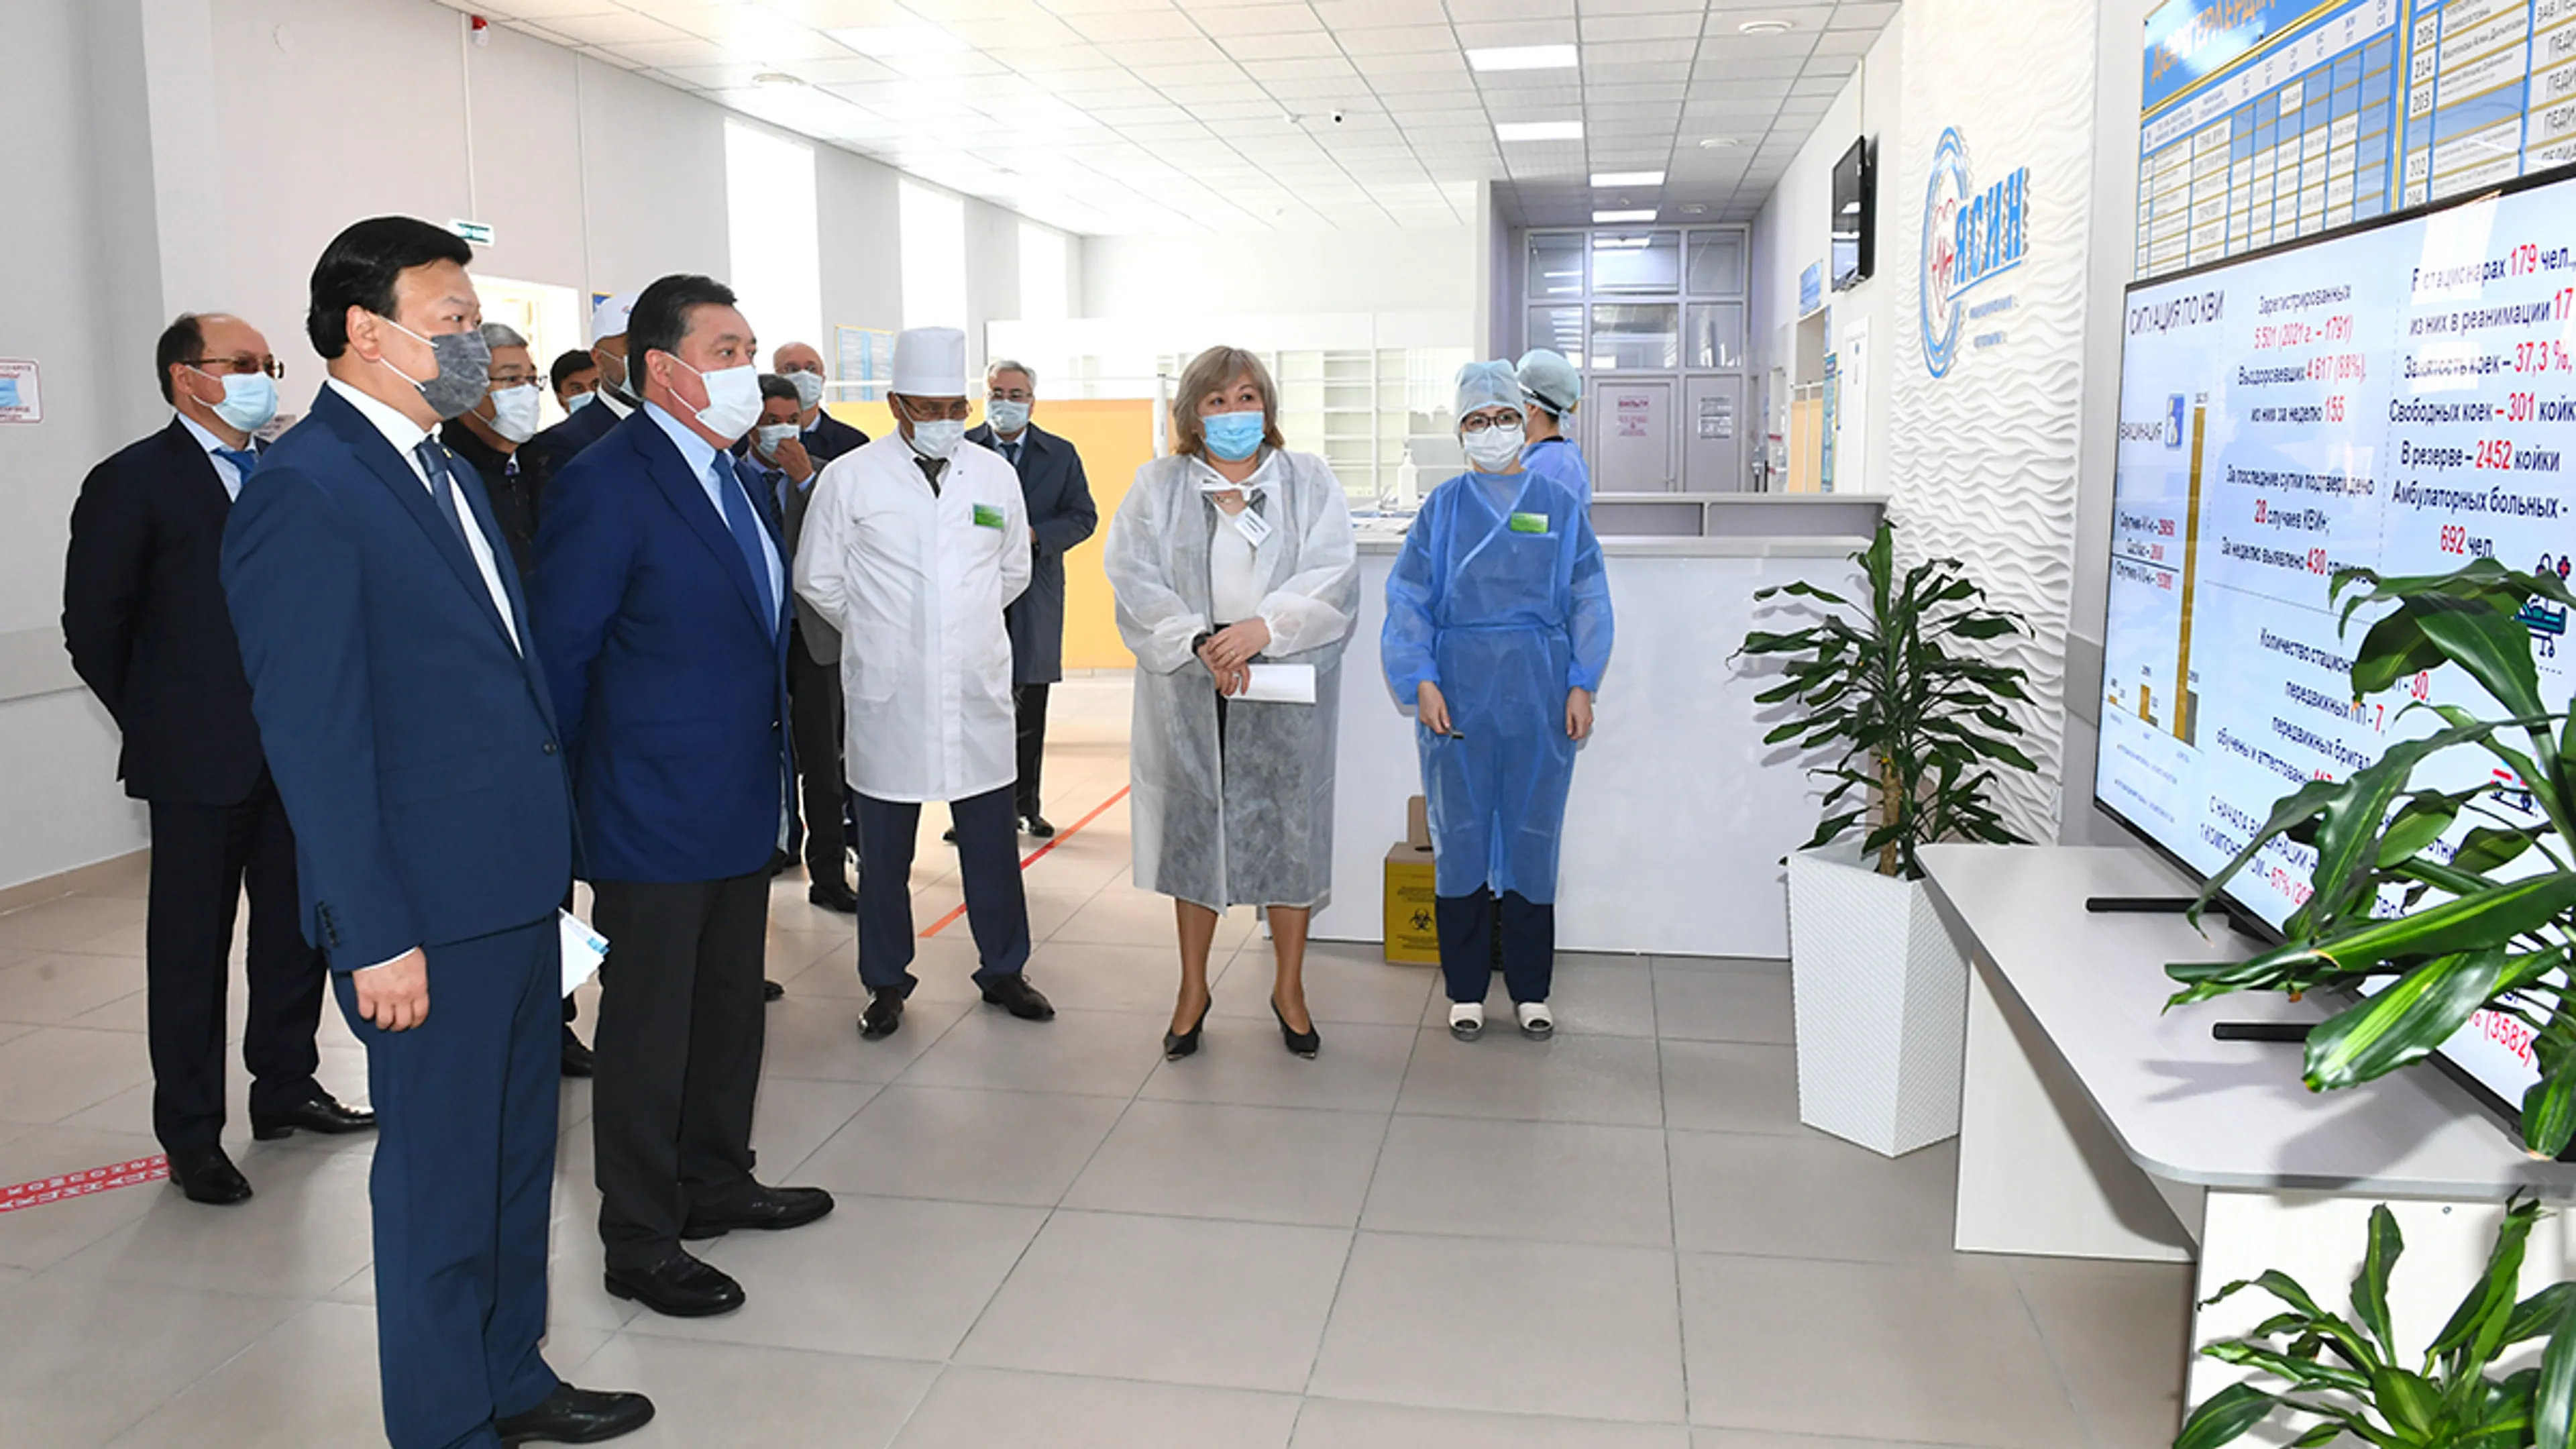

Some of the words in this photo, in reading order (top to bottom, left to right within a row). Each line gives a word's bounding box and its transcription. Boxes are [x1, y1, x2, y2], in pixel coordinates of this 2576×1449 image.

[1953, 166, 2023, 286] ЯСИН
[2510, 244, 2538, 276] 179
[2129, 299, 2180, 335] СИТУАЦИЯ
[2426, 314, 2448, 334] них
[2450, 313, 2459, 332] в
[2461, 301, 2551, 337] реанимации
[2555, 287, 2574, 320] 17
[2514, 341, 2549, 378] 37,3
[2390, 397, 2461, 426] Свободных
[2463, 402, 2493, 422] коек
[2508, 392, 2536, 422] 301
[2402, 439, 2411, 465] В
[2412, 447, 2463, 472] резерве
[2475, 439, 2513, 470] 2452
[2514, 443, 2560, 472] койки
[2392, 479, 2488, 515] Амбулаторных
[2489, 485, 2559, 519] больных
[2440, 524, 2466, 555] 692
[2484, 1010, 2533, 1068] (3582)
